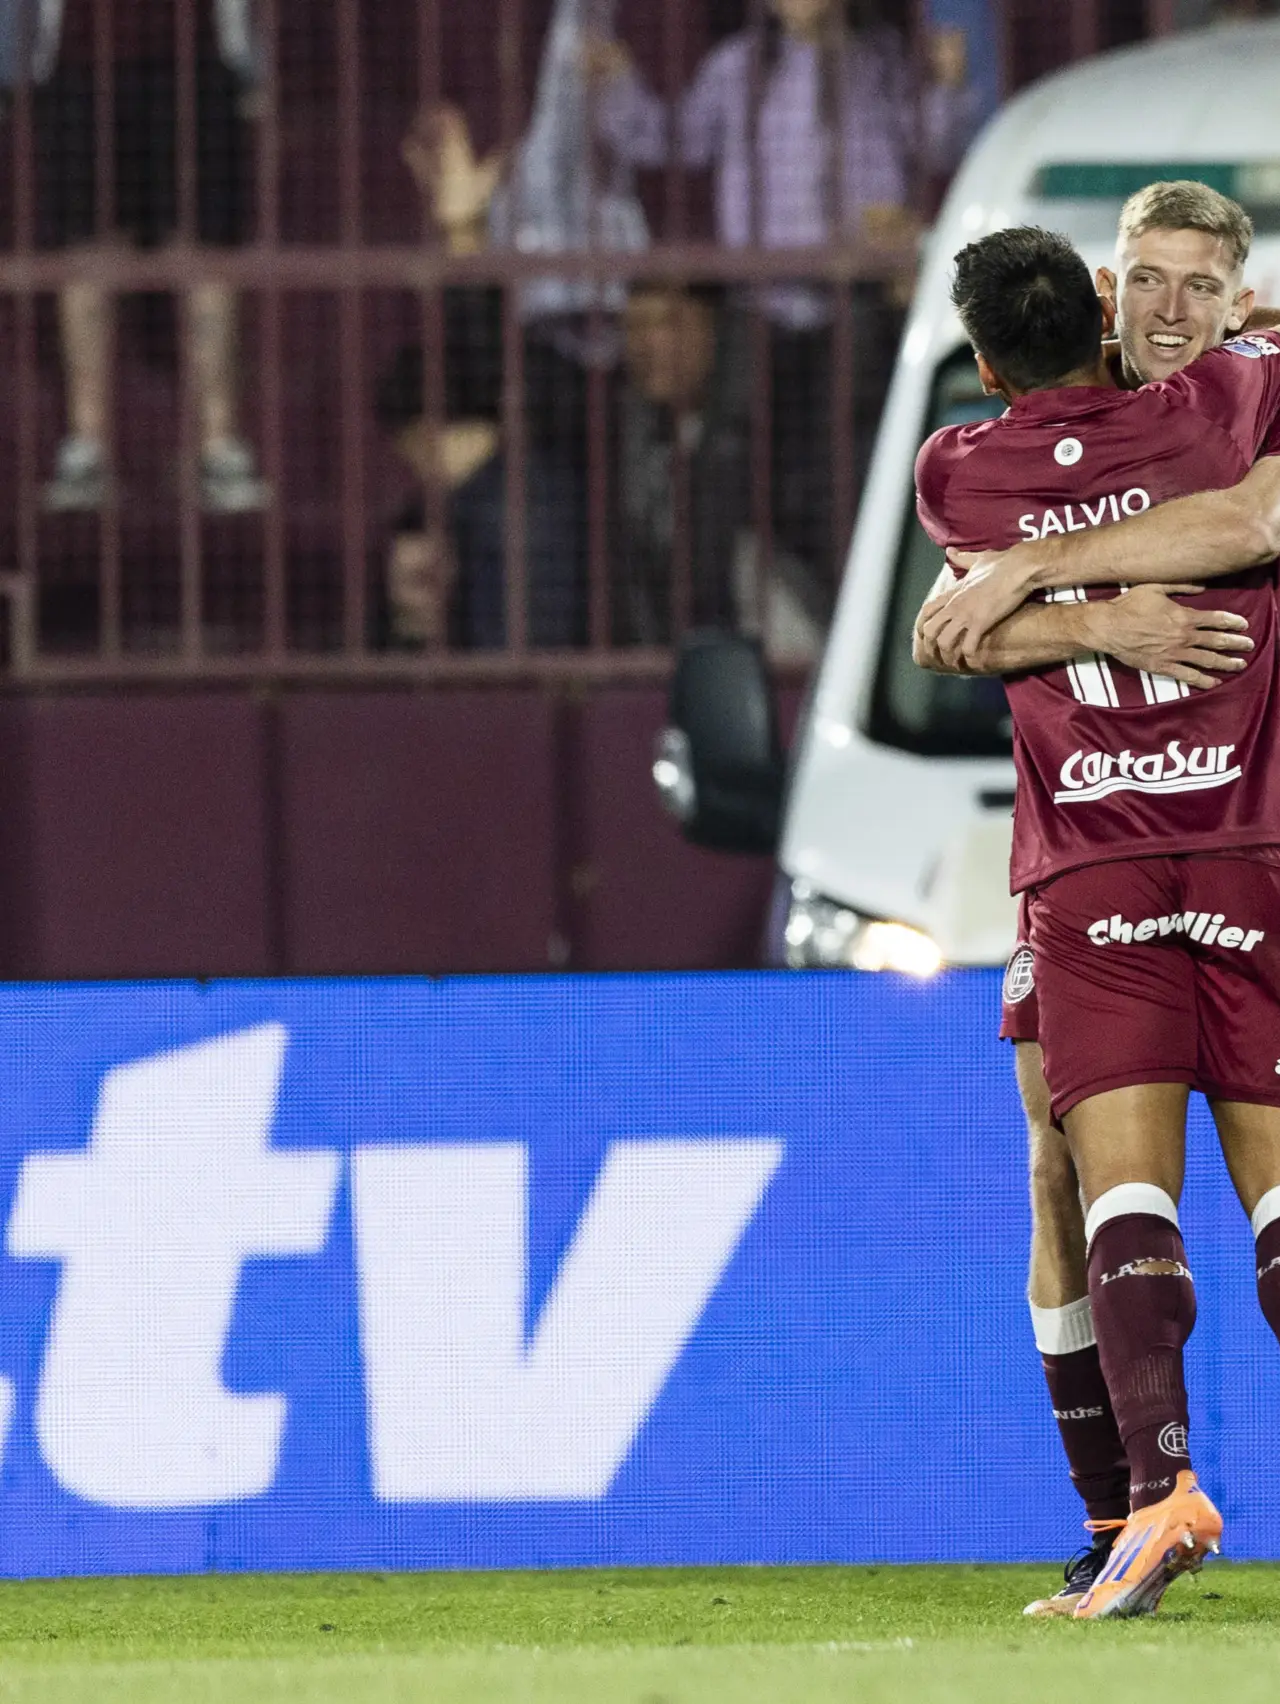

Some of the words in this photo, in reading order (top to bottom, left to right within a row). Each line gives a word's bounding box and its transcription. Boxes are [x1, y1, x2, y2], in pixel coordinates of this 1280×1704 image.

[1018, 487, 1152, 542] SALVIO
[1059, 740, 1236, 789] CartaSur
[0, 1018, 788, 1512] tv
